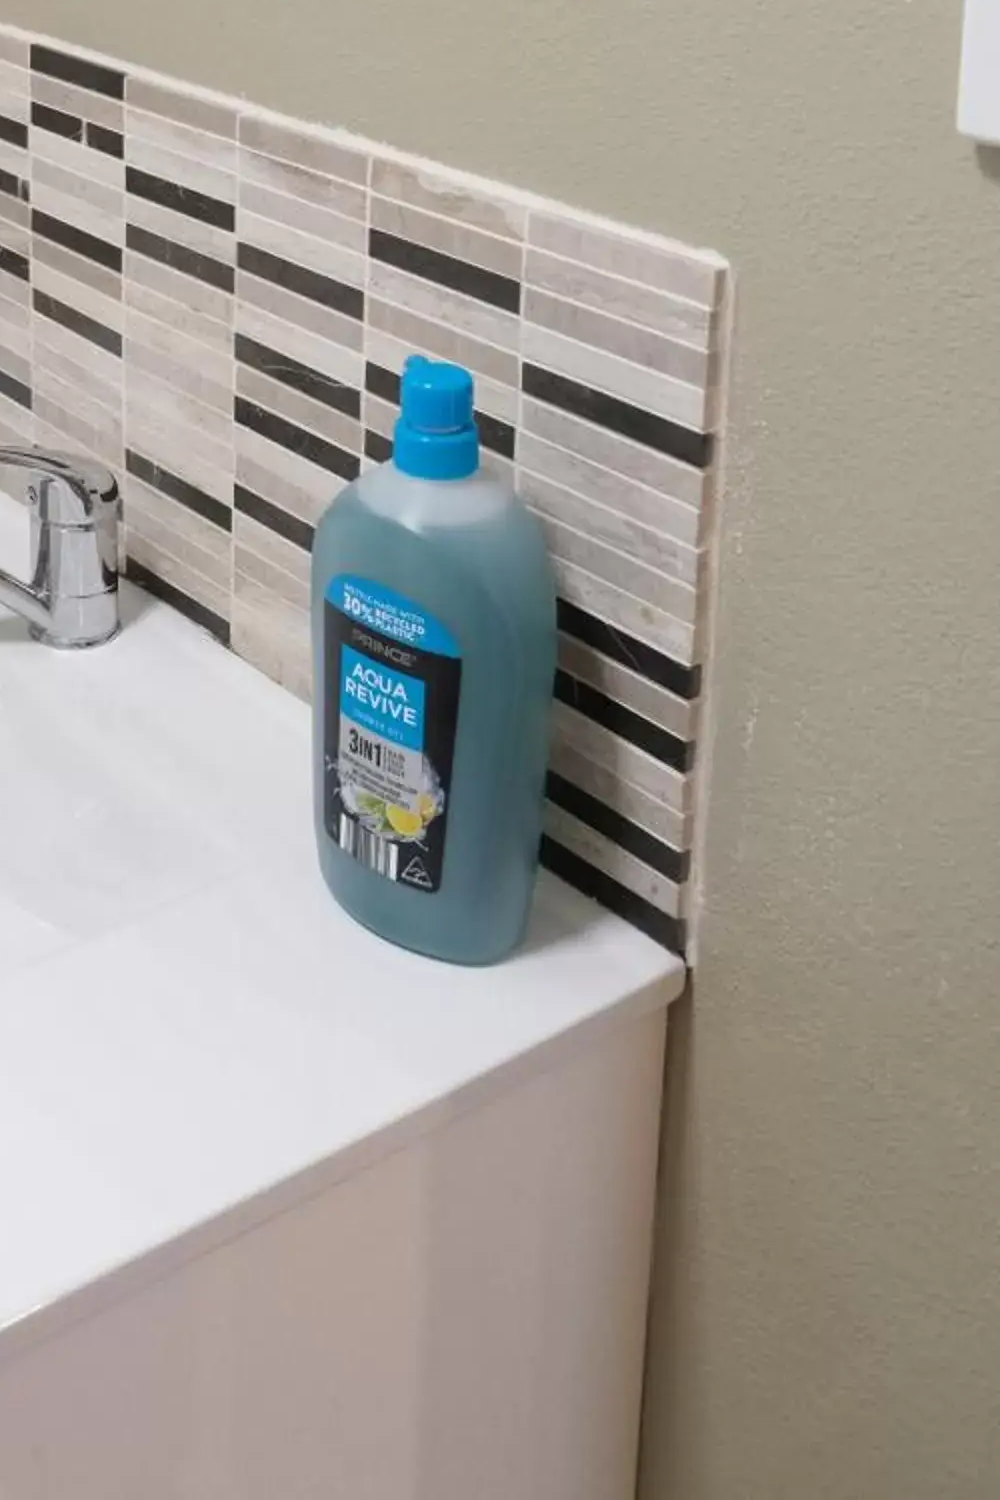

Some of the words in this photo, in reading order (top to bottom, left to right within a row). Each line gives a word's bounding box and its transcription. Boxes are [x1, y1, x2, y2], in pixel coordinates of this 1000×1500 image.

[375, 608, 425, 636] RECYCLED
[345, 676, 418, 727] REVIVE
[351, 663, 408, 702] AQUA
[349, 728, 382, 767] 3IN1
